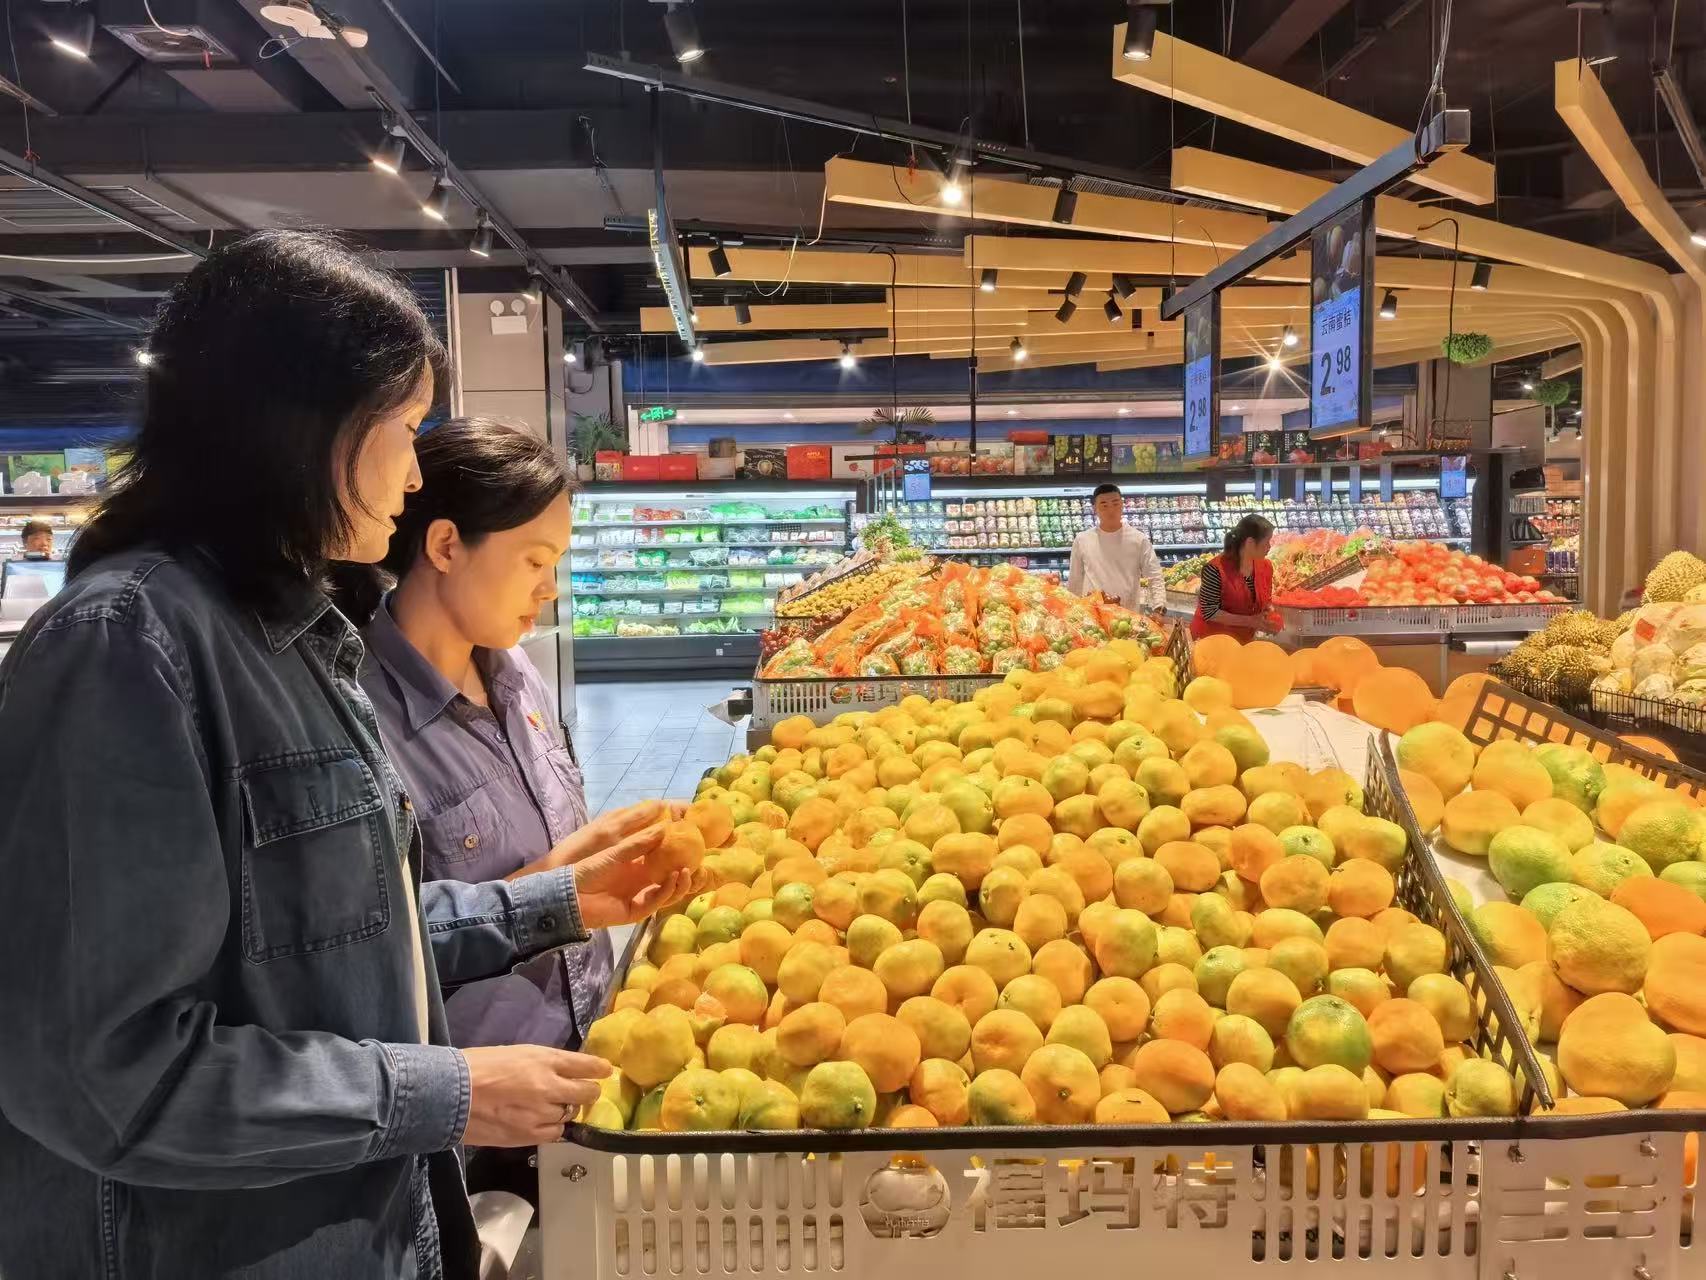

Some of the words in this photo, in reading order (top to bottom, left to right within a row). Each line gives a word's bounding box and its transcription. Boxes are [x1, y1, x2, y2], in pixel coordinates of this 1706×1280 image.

[1321, 309, 1352, 336] 云南蜜桔
[1320, 345, 1352, 396] 2.98
[1189, 397, 1207, 432] 2.98
[963, 1152, 1238, 1233] 福玛特
